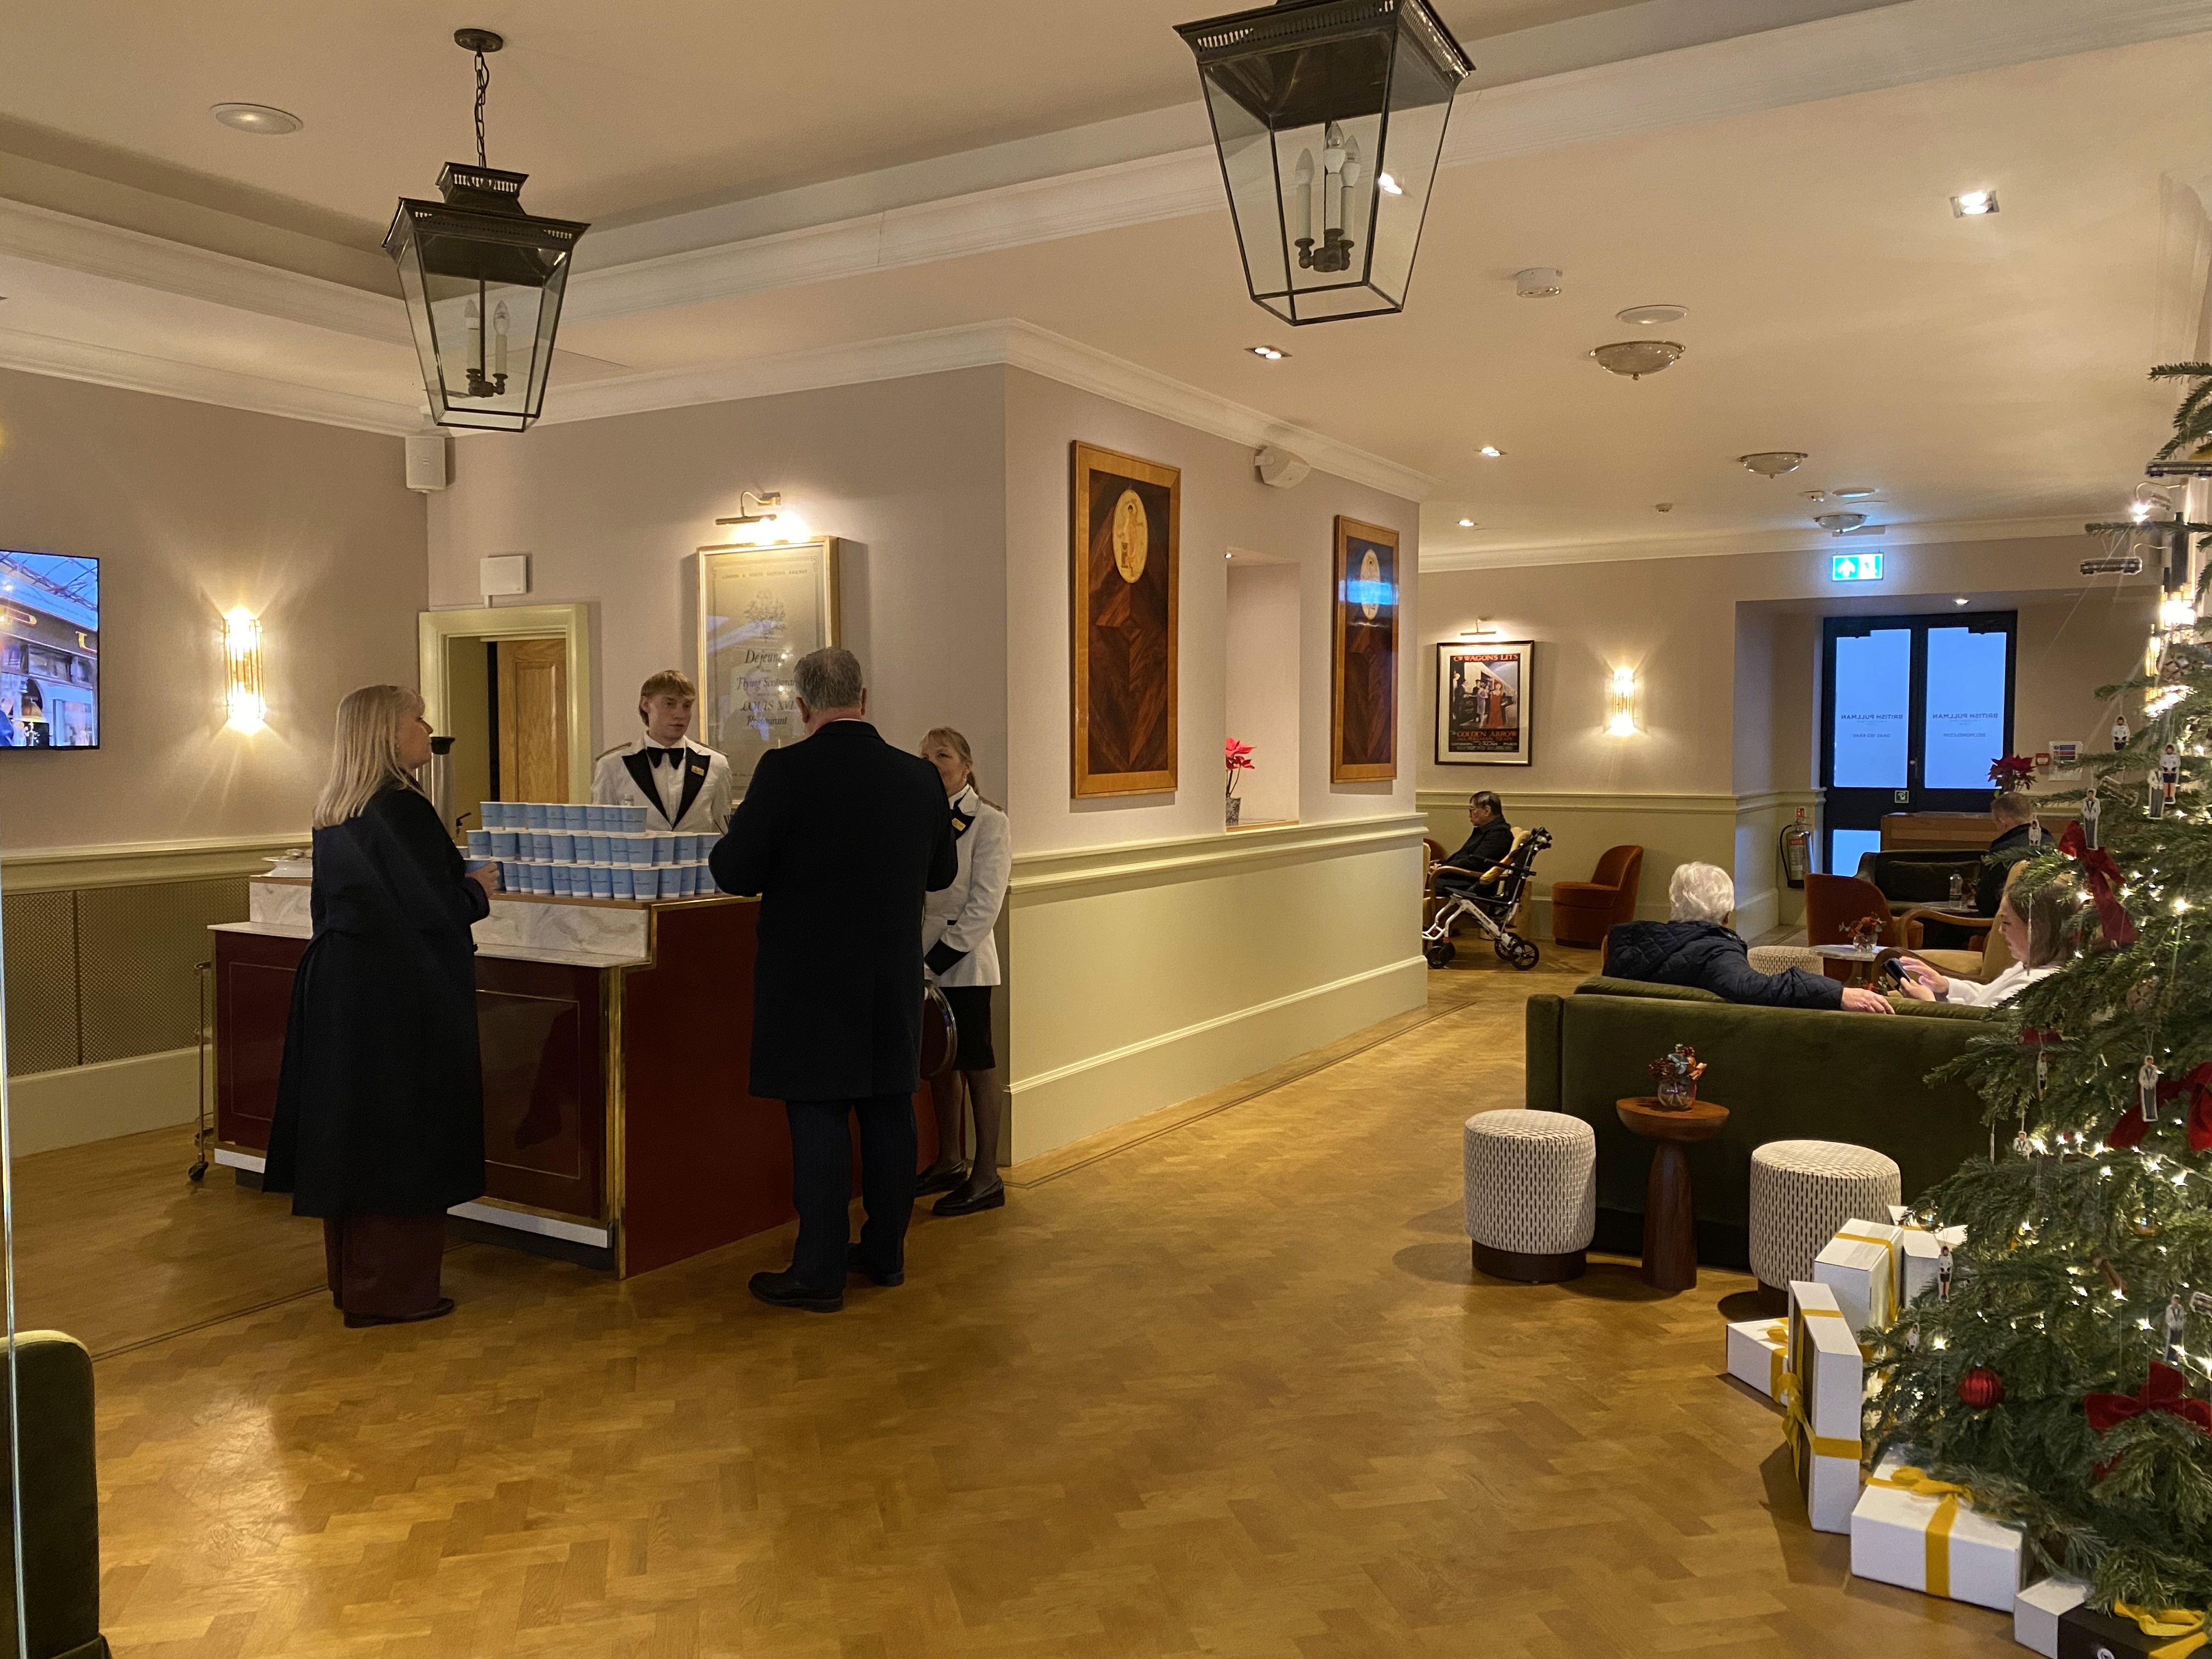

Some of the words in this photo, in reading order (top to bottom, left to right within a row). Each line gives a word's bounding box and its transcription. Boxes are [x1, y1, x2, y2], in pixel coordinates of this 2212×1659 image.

[737, 677, 761, 692] Flying
[741, 701, 774, 711] LOUIS
[777, 700, 794, 710] XVI
